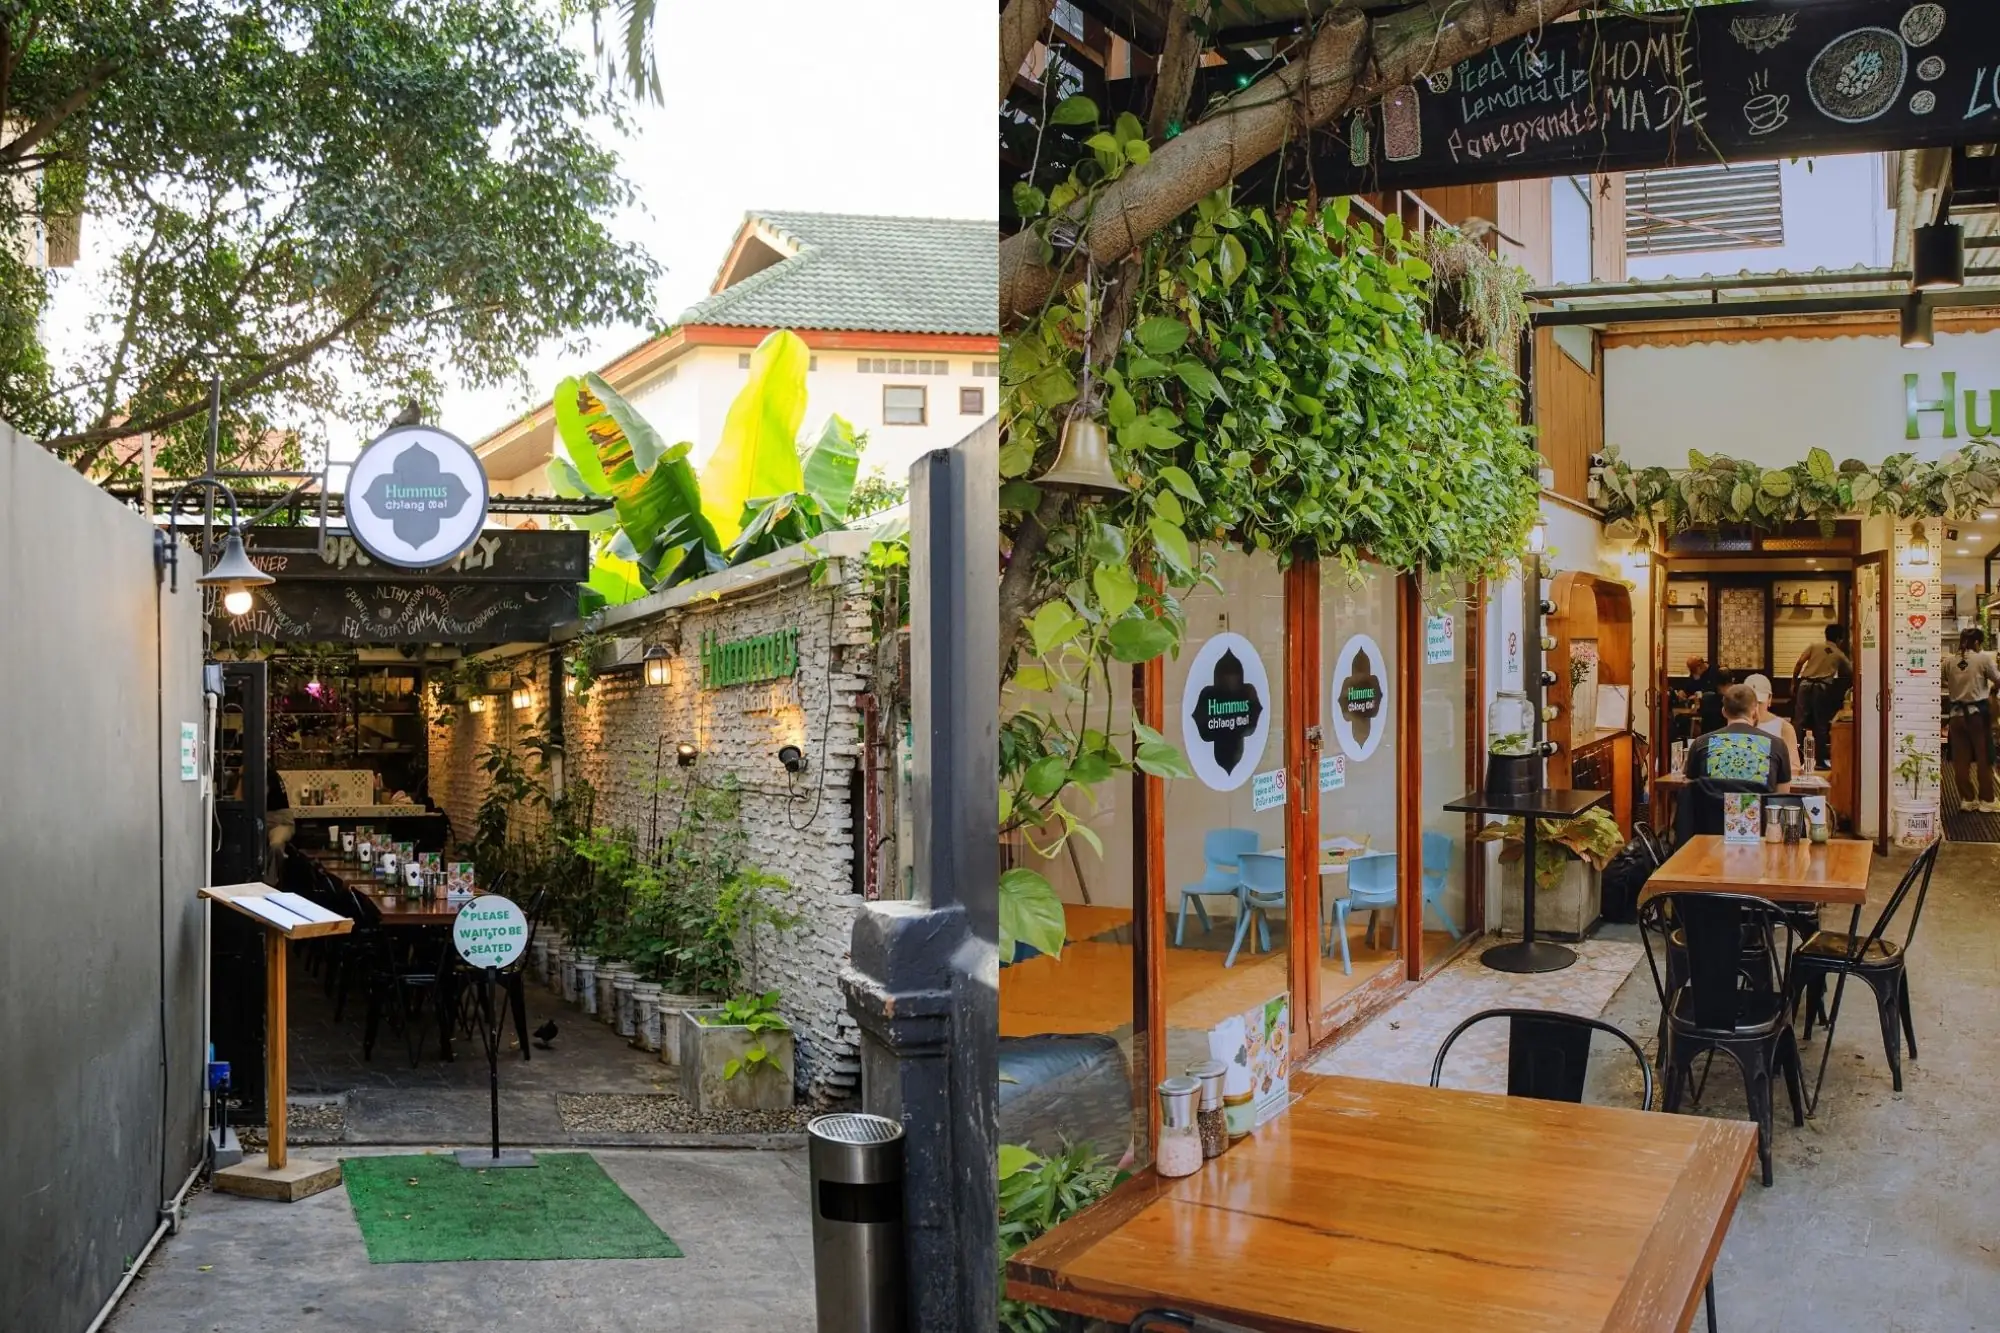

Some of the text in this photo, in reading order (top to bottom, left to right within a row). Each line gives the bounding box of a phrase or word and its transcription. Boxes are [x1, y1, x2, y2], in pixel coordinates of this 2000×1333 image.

[1602, 32, 1693, 81] HOME
[1602, 80, 1708, 132] MADE
[385, 484, 448, 498] Hummus
[229, 609, 283, 641] TAHINI
[698, 625, 799, 690] Hummus
[1348, 686, 1376, 701] Hummus
[1208, 698, 1249, 716] Hummus
[470, 910, 510, 921] PLEASE
[460, 926, 522, 938] WAIT TO BE
[470, 943, 513, 954] SEATED
